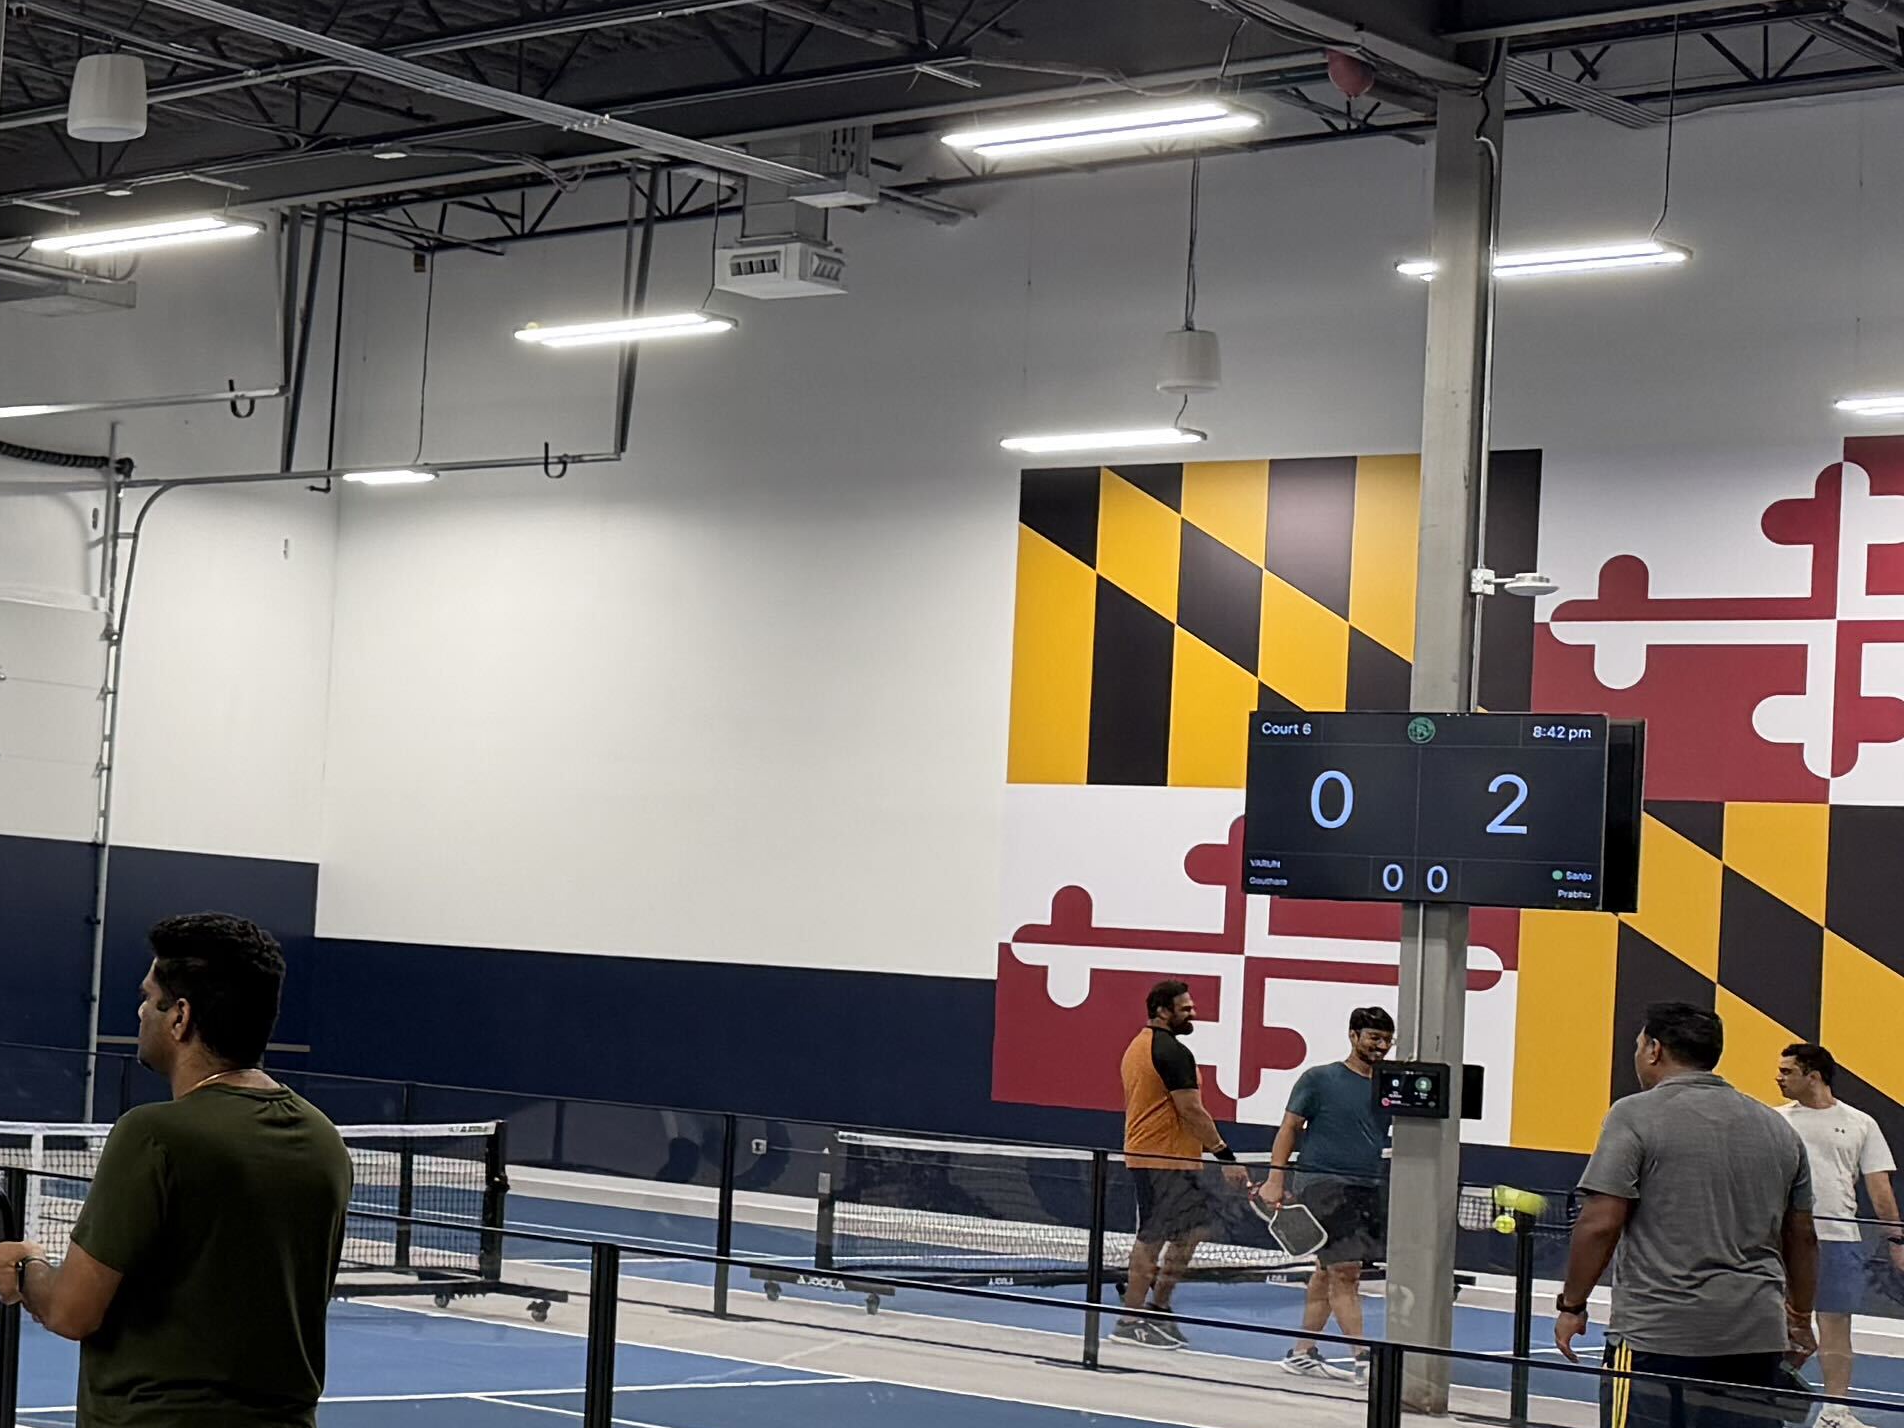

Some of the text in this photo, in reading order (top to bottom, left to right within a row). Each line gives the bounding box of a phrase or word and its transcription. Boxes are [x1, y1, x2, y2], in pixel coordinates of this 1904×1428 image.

[1261, 722, 1312, 735] Court 6
[1533, 725, 1592, 741] 8:42 pm
[1310, 770, 1354, 829] 0
[1486, 773, 1528, 834] 2
[1383, 864, 1404, 892] 0
[1427, 865, 1448, 893] 0
